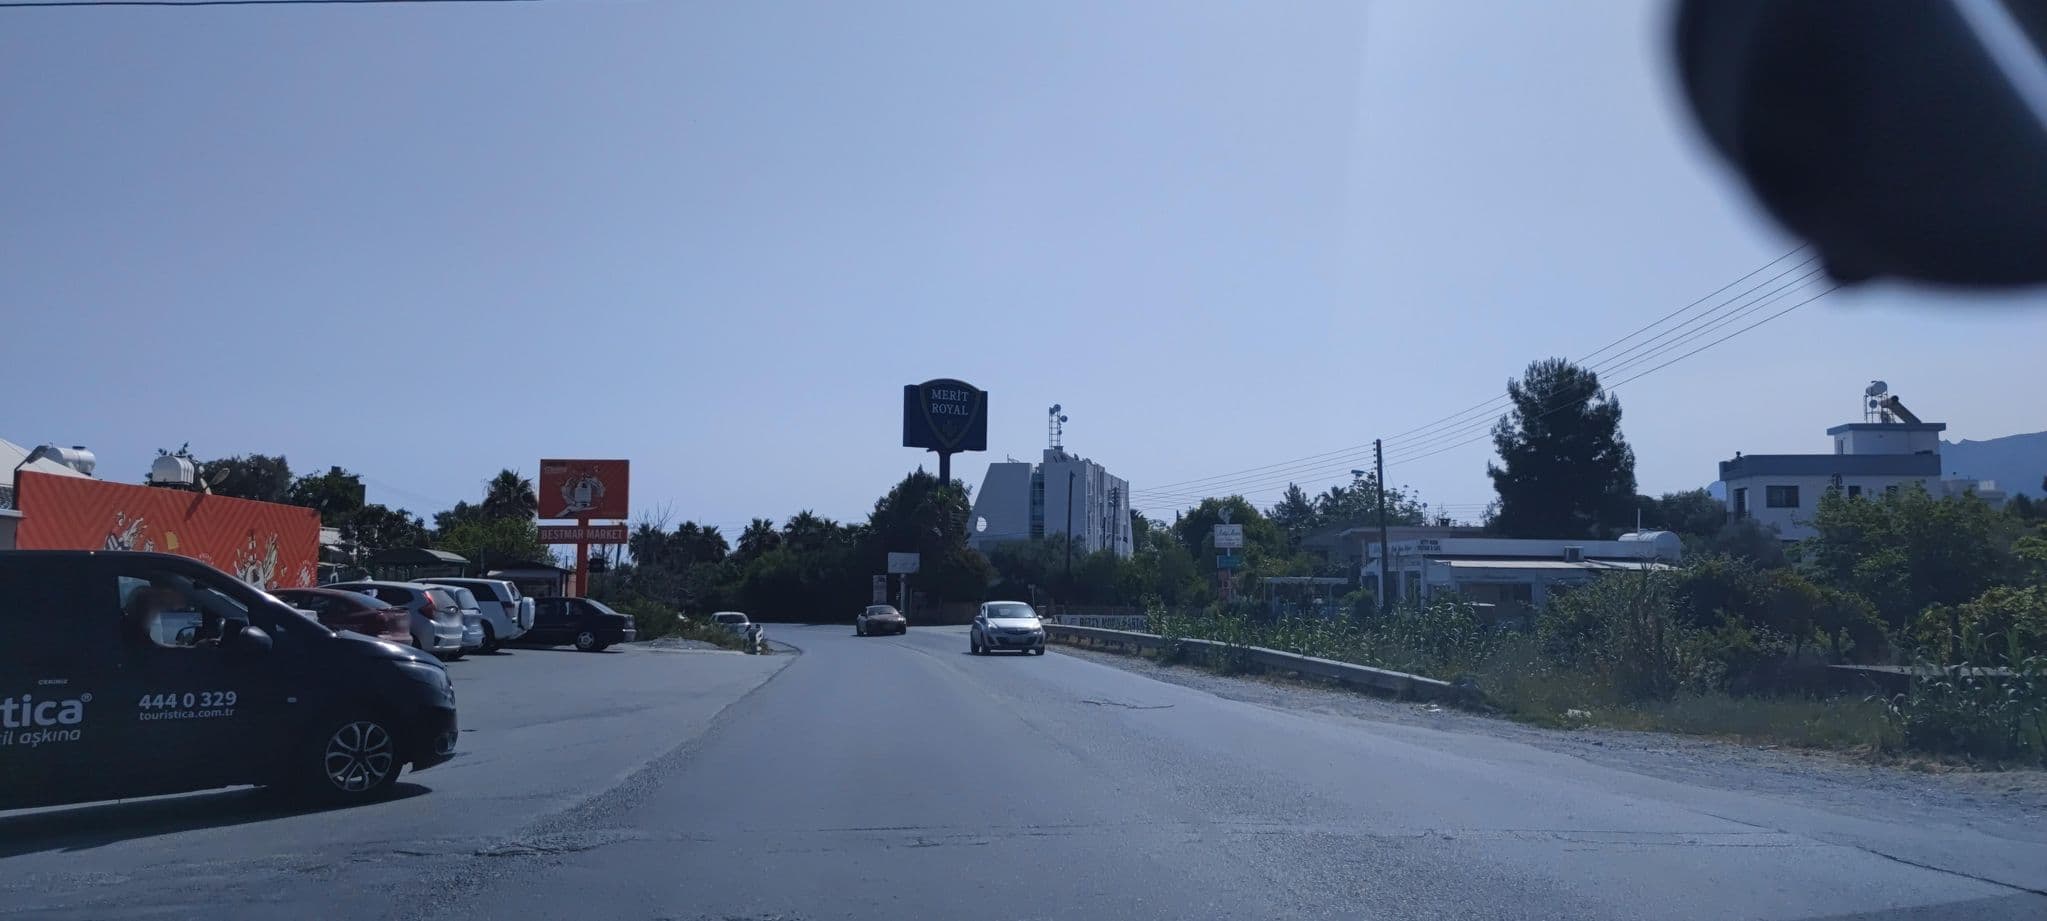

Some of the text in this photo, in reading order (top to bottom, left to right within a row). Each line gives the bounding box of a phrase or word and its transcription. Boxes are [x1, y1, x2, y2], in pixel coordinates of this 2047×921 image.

[931, 403, 969, 415] ROYAL
[542, 528, 624, 541] BESTMAR MARKET
[138, 691, 238, 710] 444 0 329
[139, 707, 235, 721] touristica.com.tr
[0, 729, 81, 748] il aşkına
